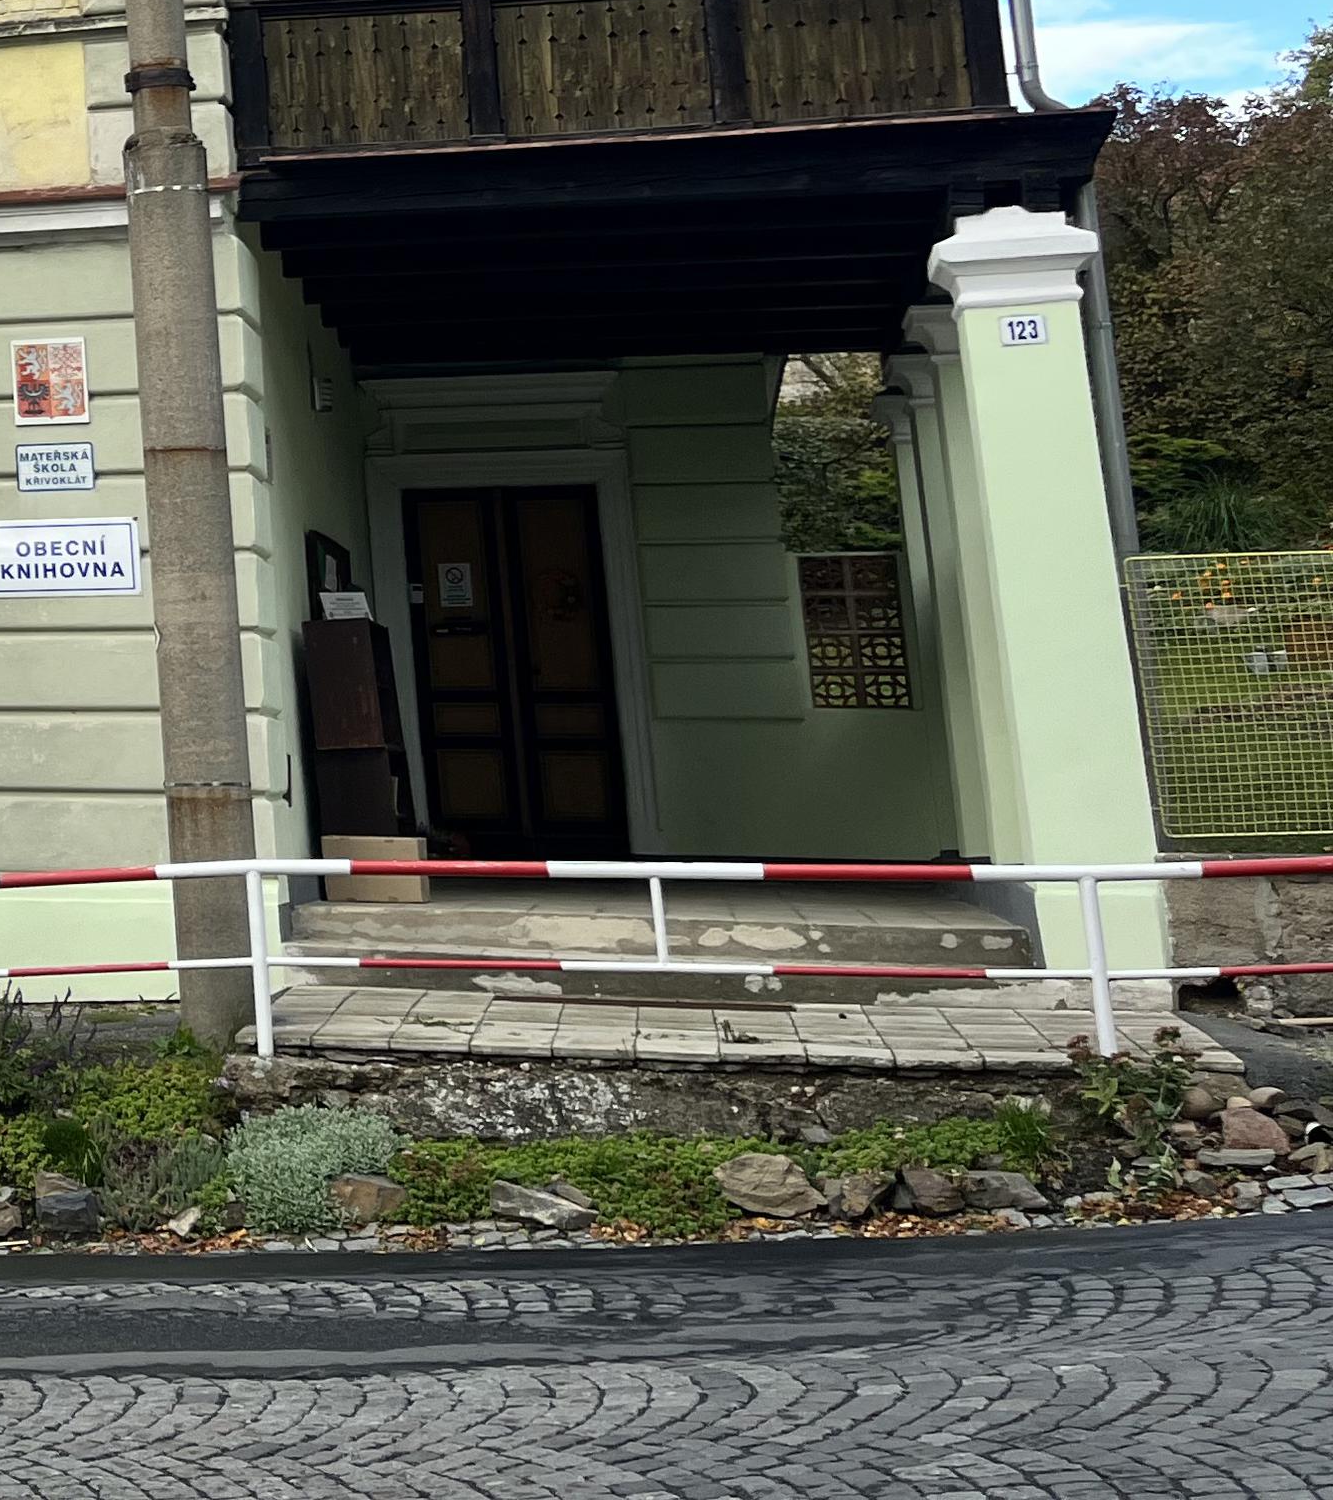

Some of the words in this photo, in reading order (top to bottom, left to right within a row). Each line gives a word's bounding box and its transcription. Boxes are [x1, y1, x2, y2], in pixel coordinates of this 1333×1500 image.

[1008, 319, 1038, 340] 123
[19, 449, 89, 462] MATEŘSKÁ
[33, 461, 77, 473] ŠKOLA
[25, 475, 88, 486] KŘIVOKLÁT
[15, 534, 106, 557] OBECNÍ
[0, 561, 125, 579] KNIHOVNA
